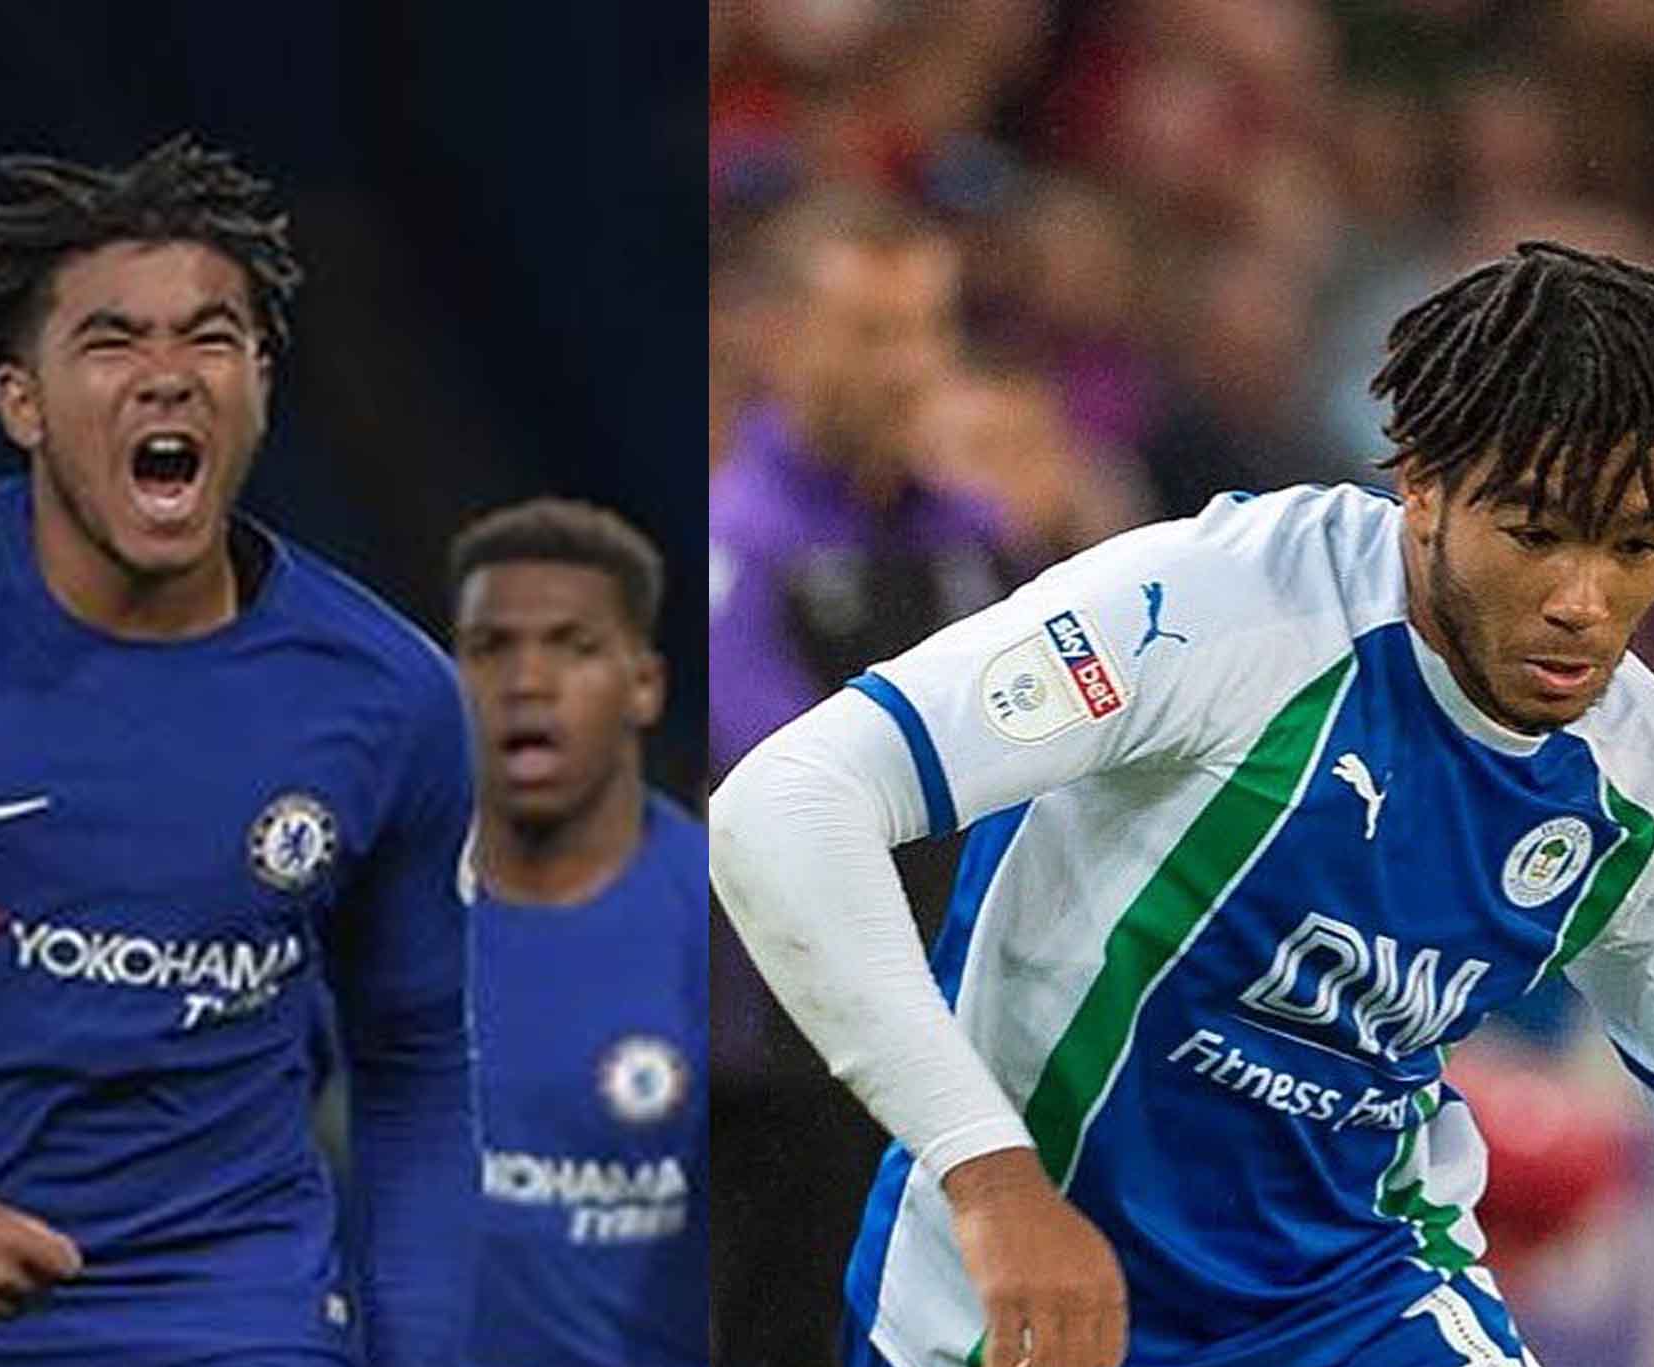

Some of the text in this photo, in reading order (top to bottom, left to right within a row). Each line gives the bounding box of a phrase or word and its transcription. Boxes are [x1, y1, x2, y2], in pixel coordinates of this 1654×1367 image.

[1049, 617, 1121, 715] sky bet
[1238, 911, 1491, 1062] DW
[1167, 1029, 1342, 1120] Fitness
